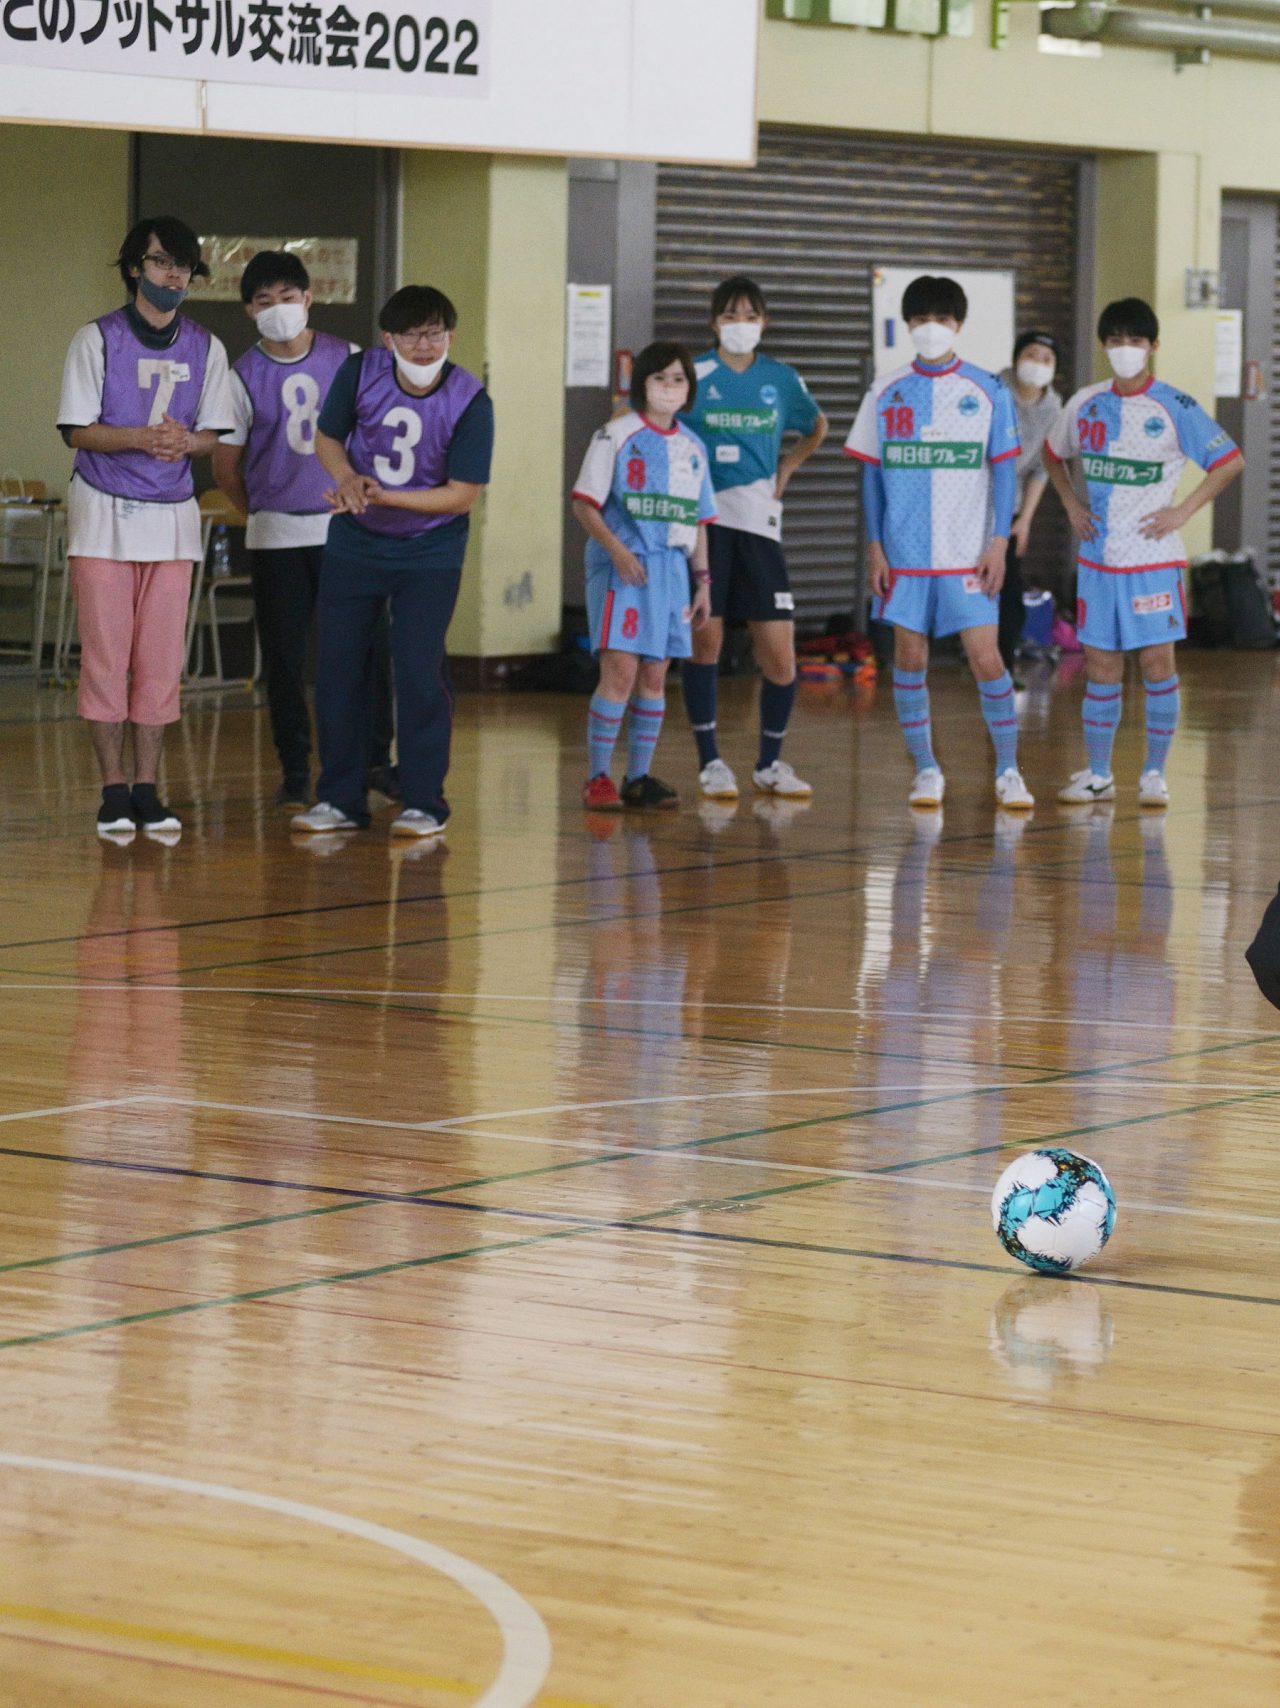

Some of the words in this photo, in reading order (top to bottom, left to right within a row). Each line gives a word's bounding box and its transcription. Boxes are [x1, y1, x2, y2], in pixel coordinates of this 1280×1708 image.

[138, 358, 177, 427] 7
[281, 372, 320, 455] 8
[882, 405, 915, 440] 18
[373, 406, 423, 486] 3
[1077, 418, 1107, 452] 20
[625, 458, 647, 491] 8
[621, 607, 640, 640] 8
